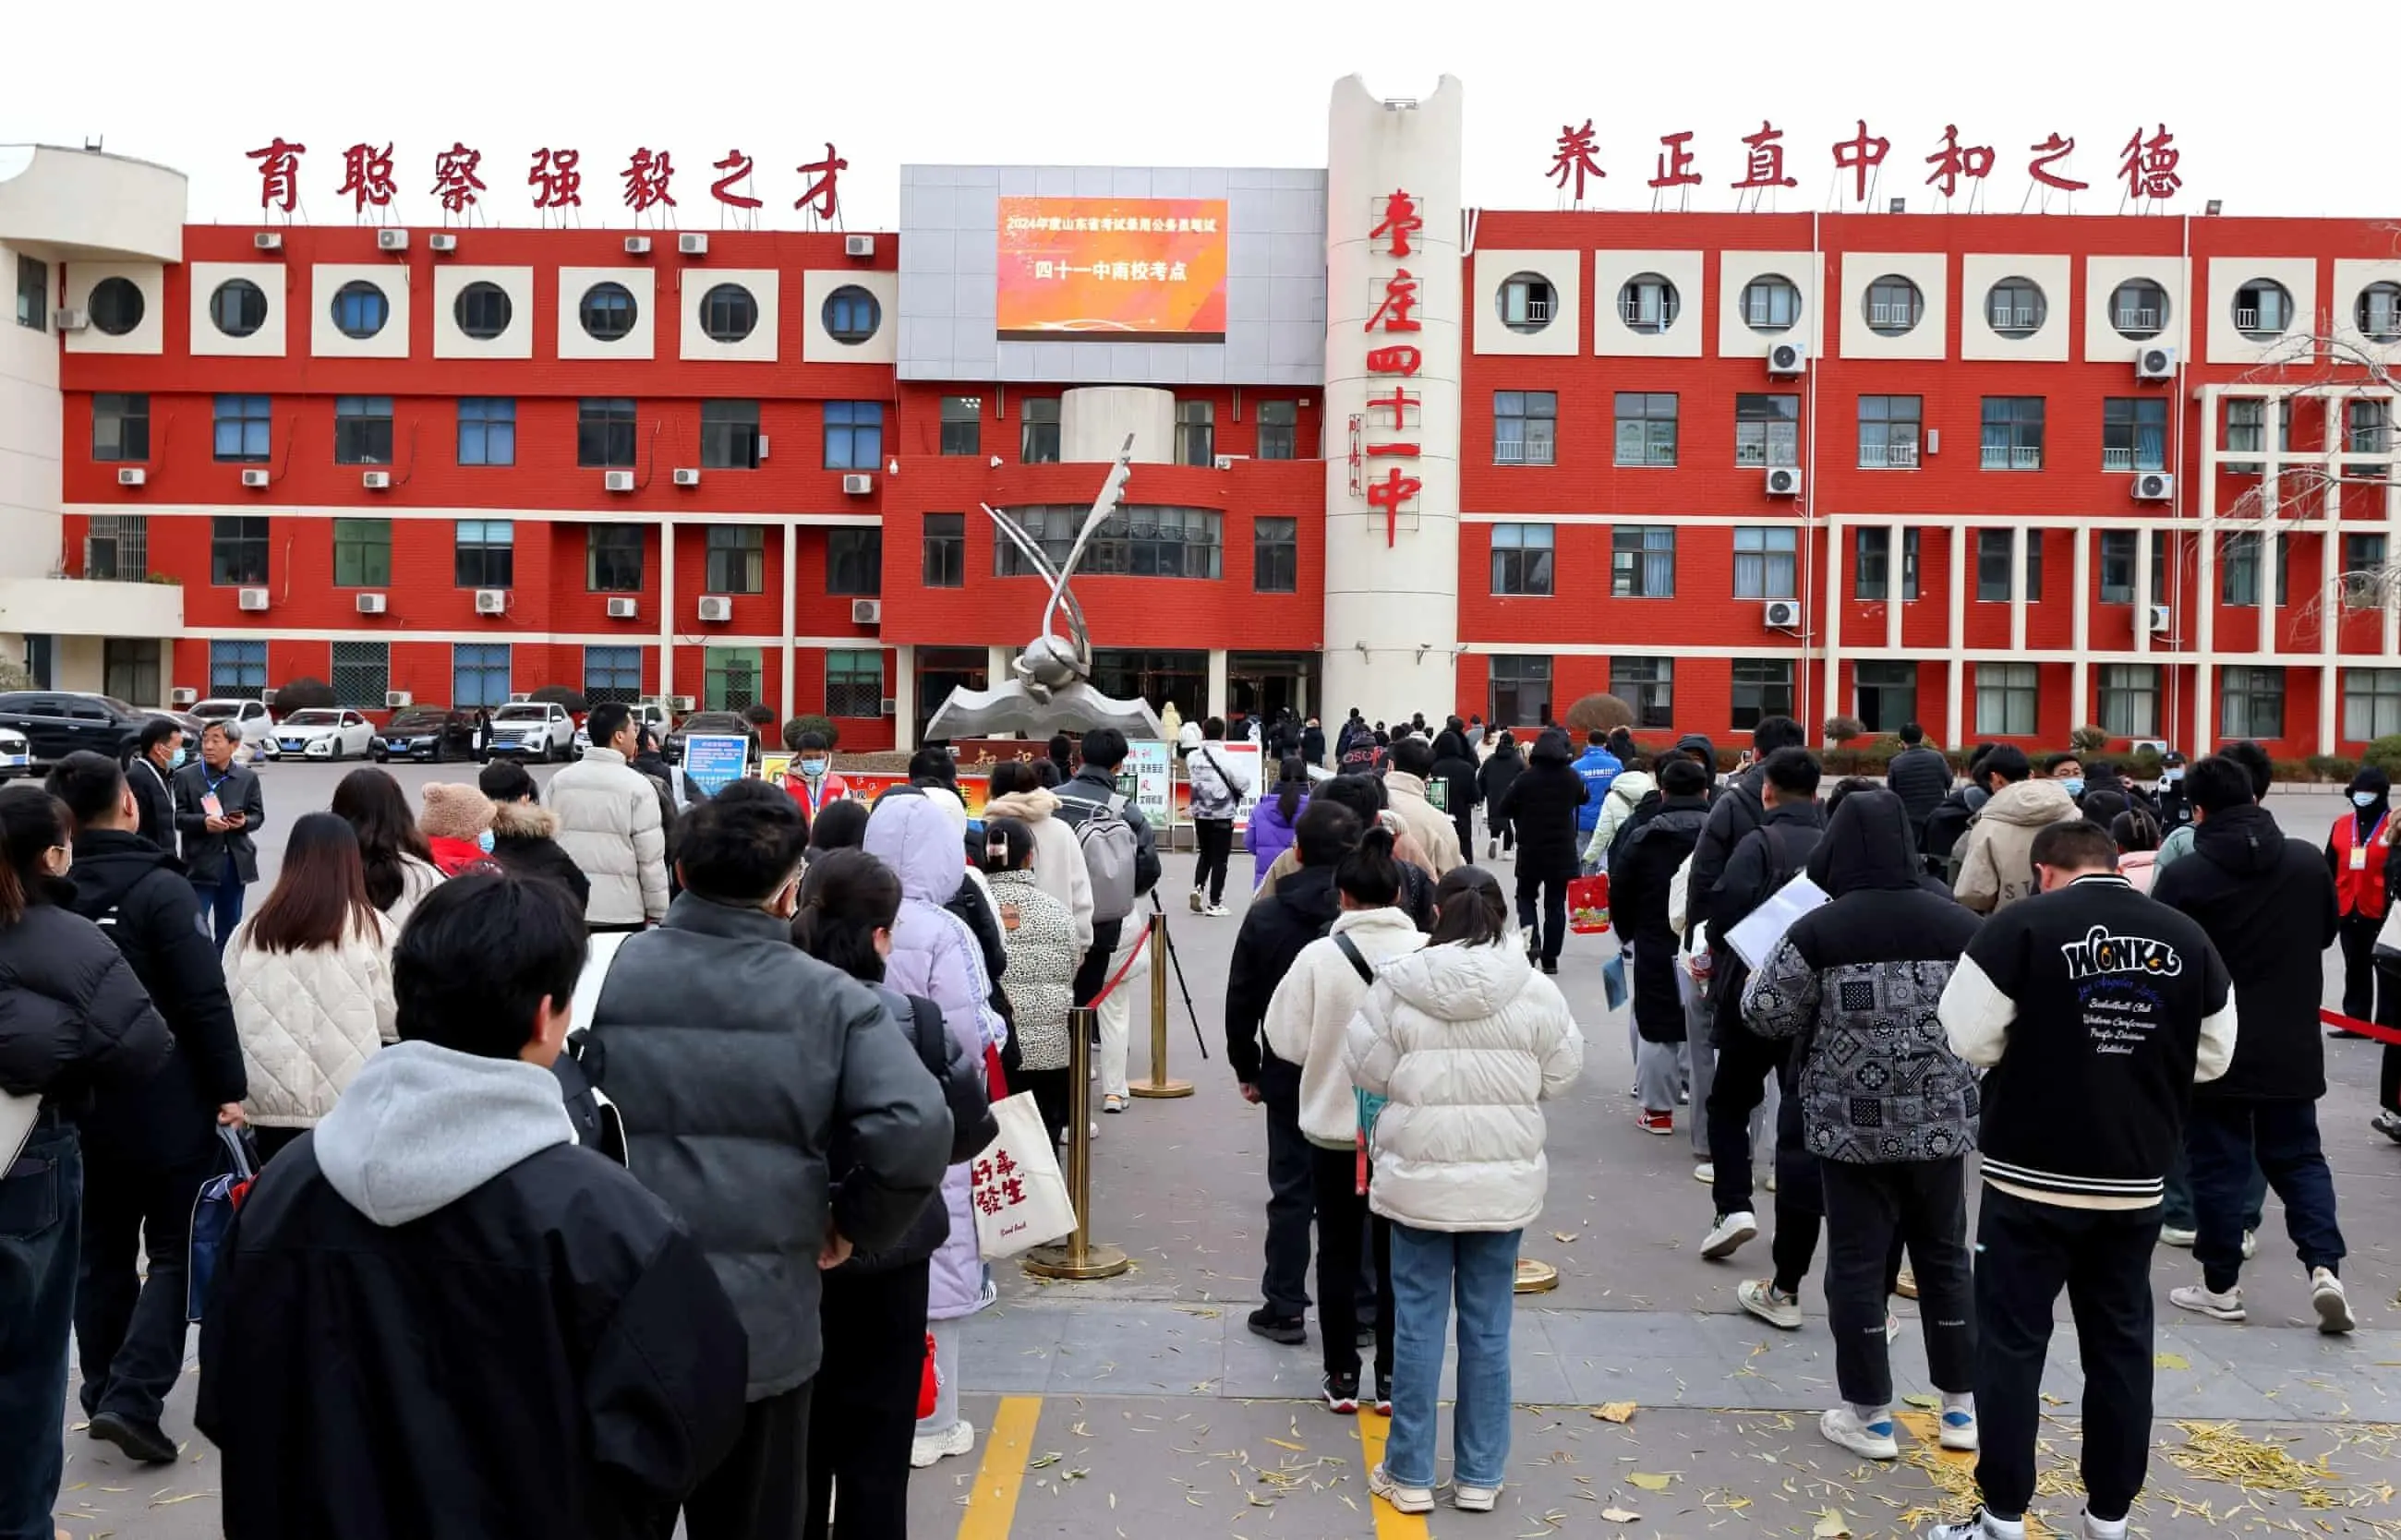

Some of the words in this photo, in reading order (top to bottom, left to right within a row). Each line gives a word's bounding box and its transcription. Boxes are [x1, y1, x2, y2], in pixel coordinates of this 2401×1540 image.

[246, 138, 848, 220] 育聪察强毅之才
[1546, 120, 2182, 201] 养正直中和之德
[1035, 259, 1188, 282] 四十一中南校考点
